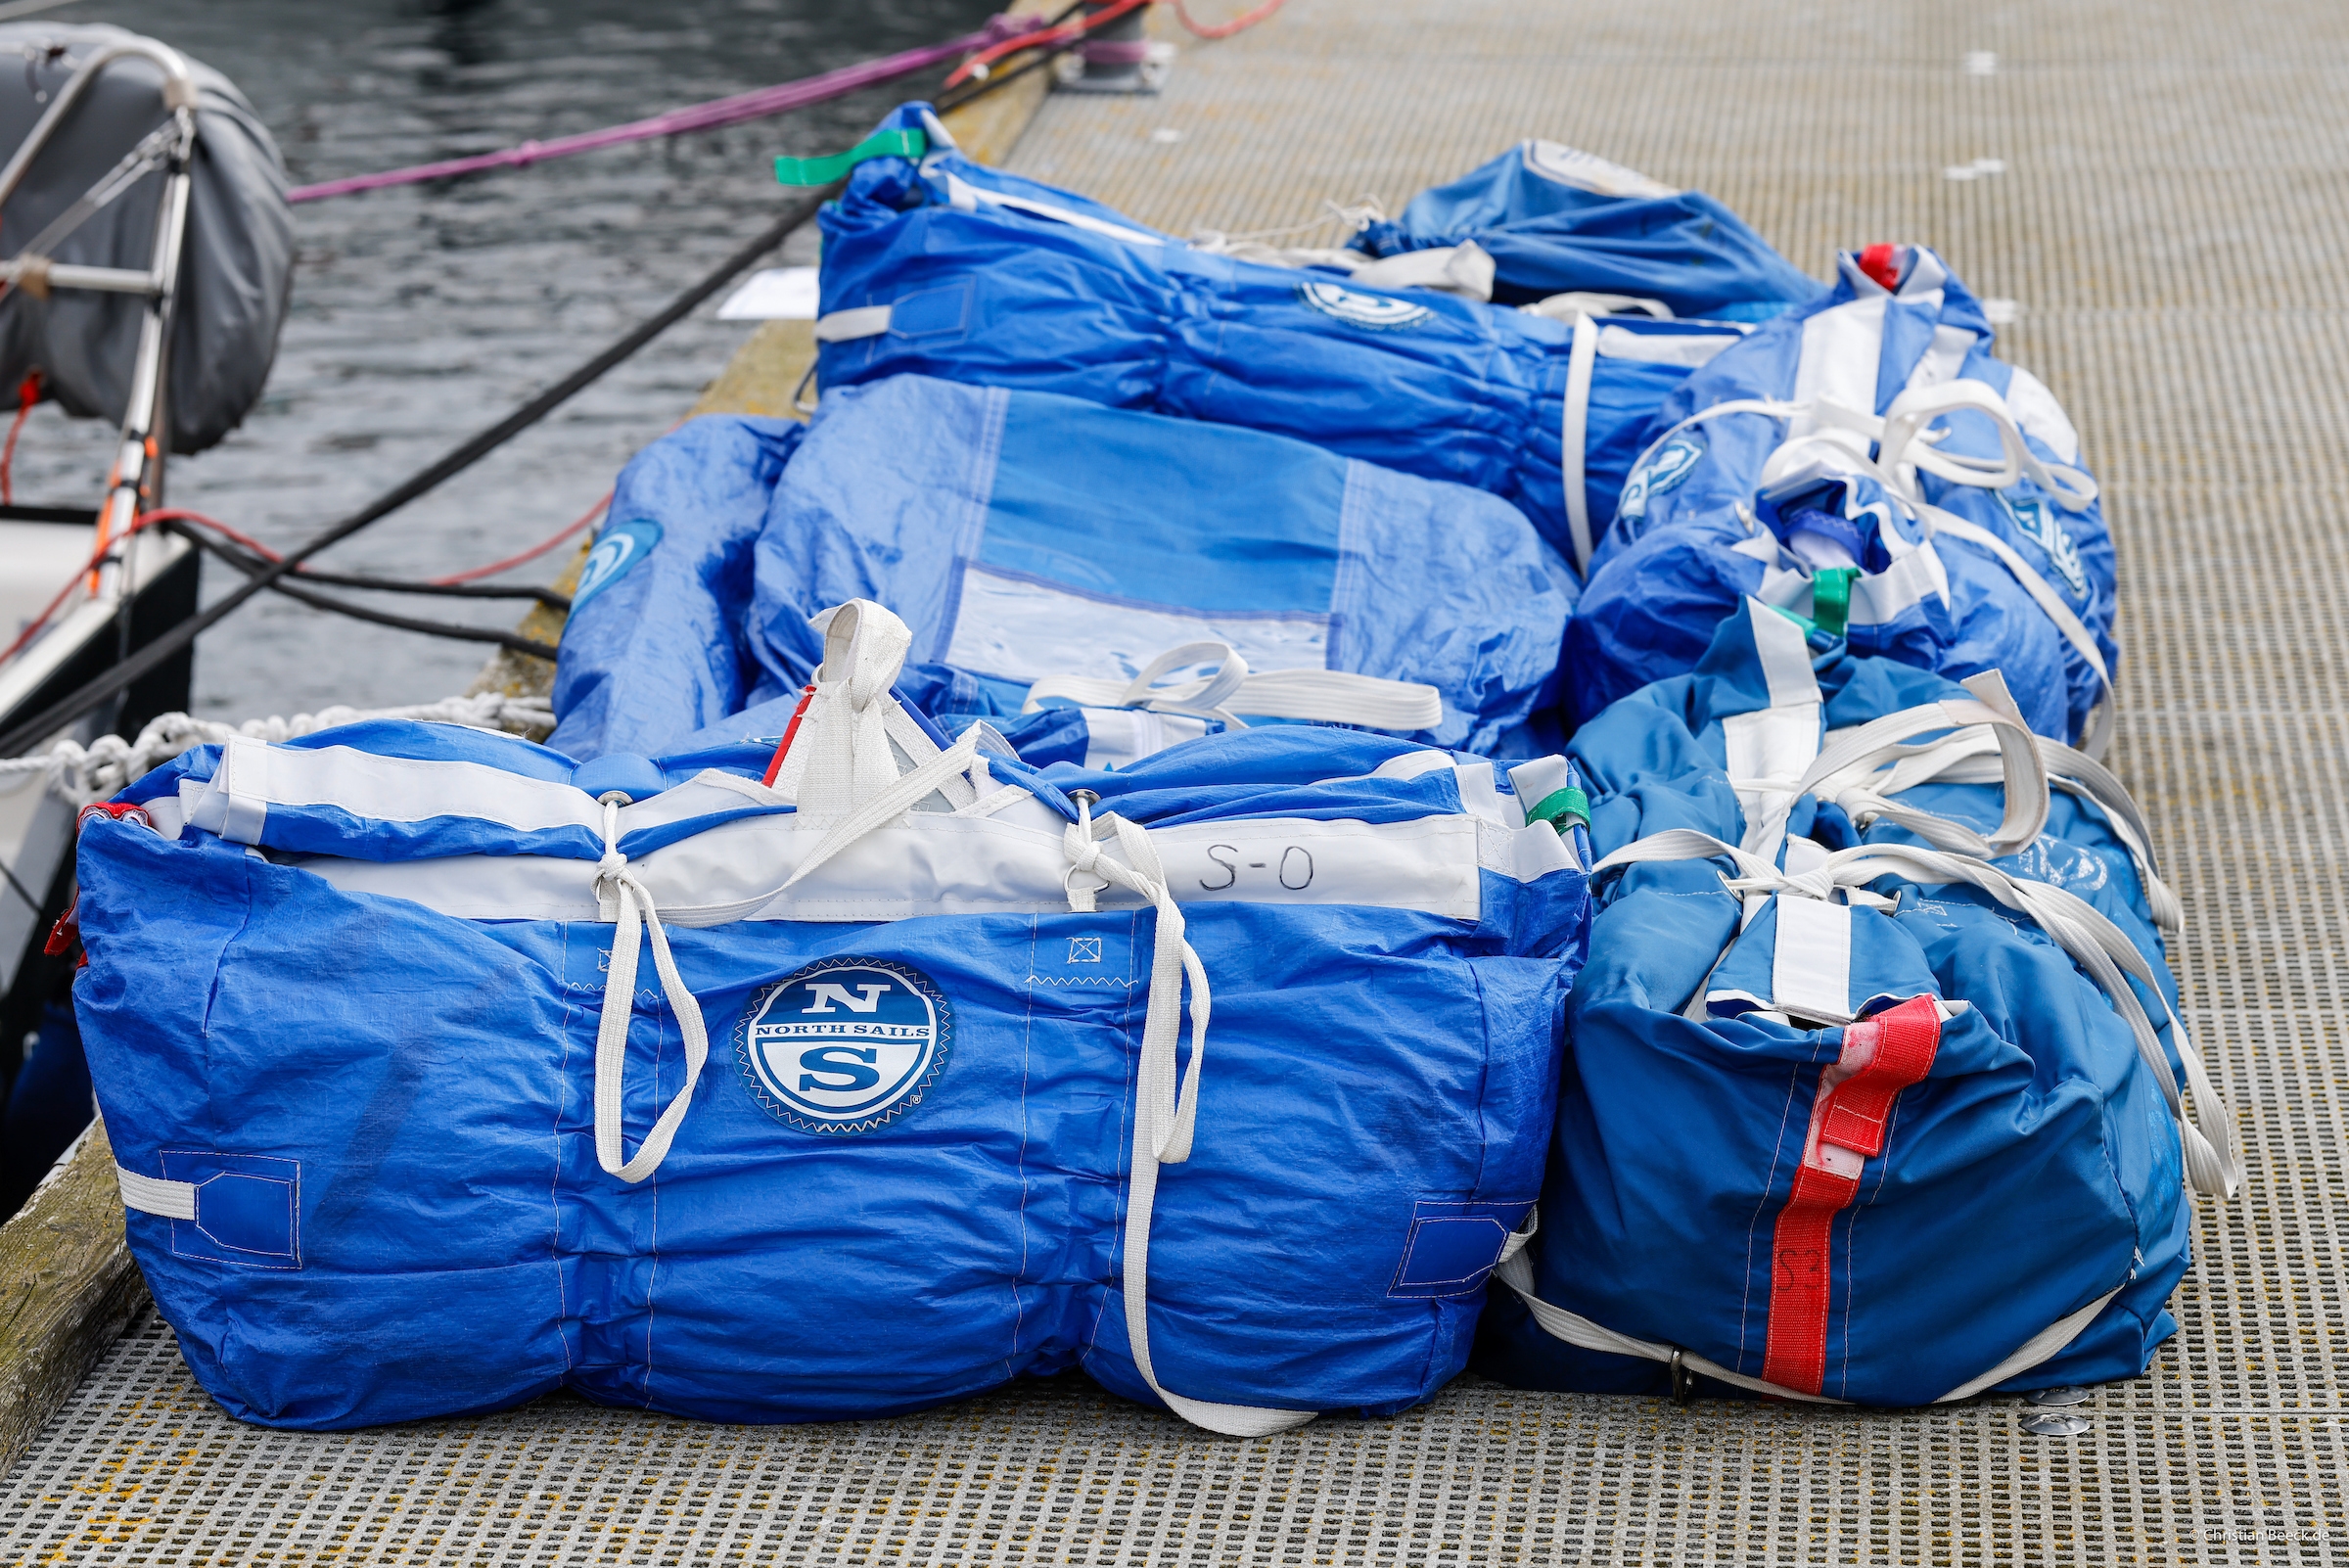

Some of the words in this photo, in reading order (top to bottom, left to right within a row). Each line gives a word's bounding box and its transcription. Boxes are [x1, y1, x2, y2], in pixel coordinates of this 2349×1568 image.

[802, 983, 892, 1014] N
[755, 1024, 847, 1036] NORTH
[853, 1024, 930, 1037] SAILS
[799, 1046, 881, 1092] S
